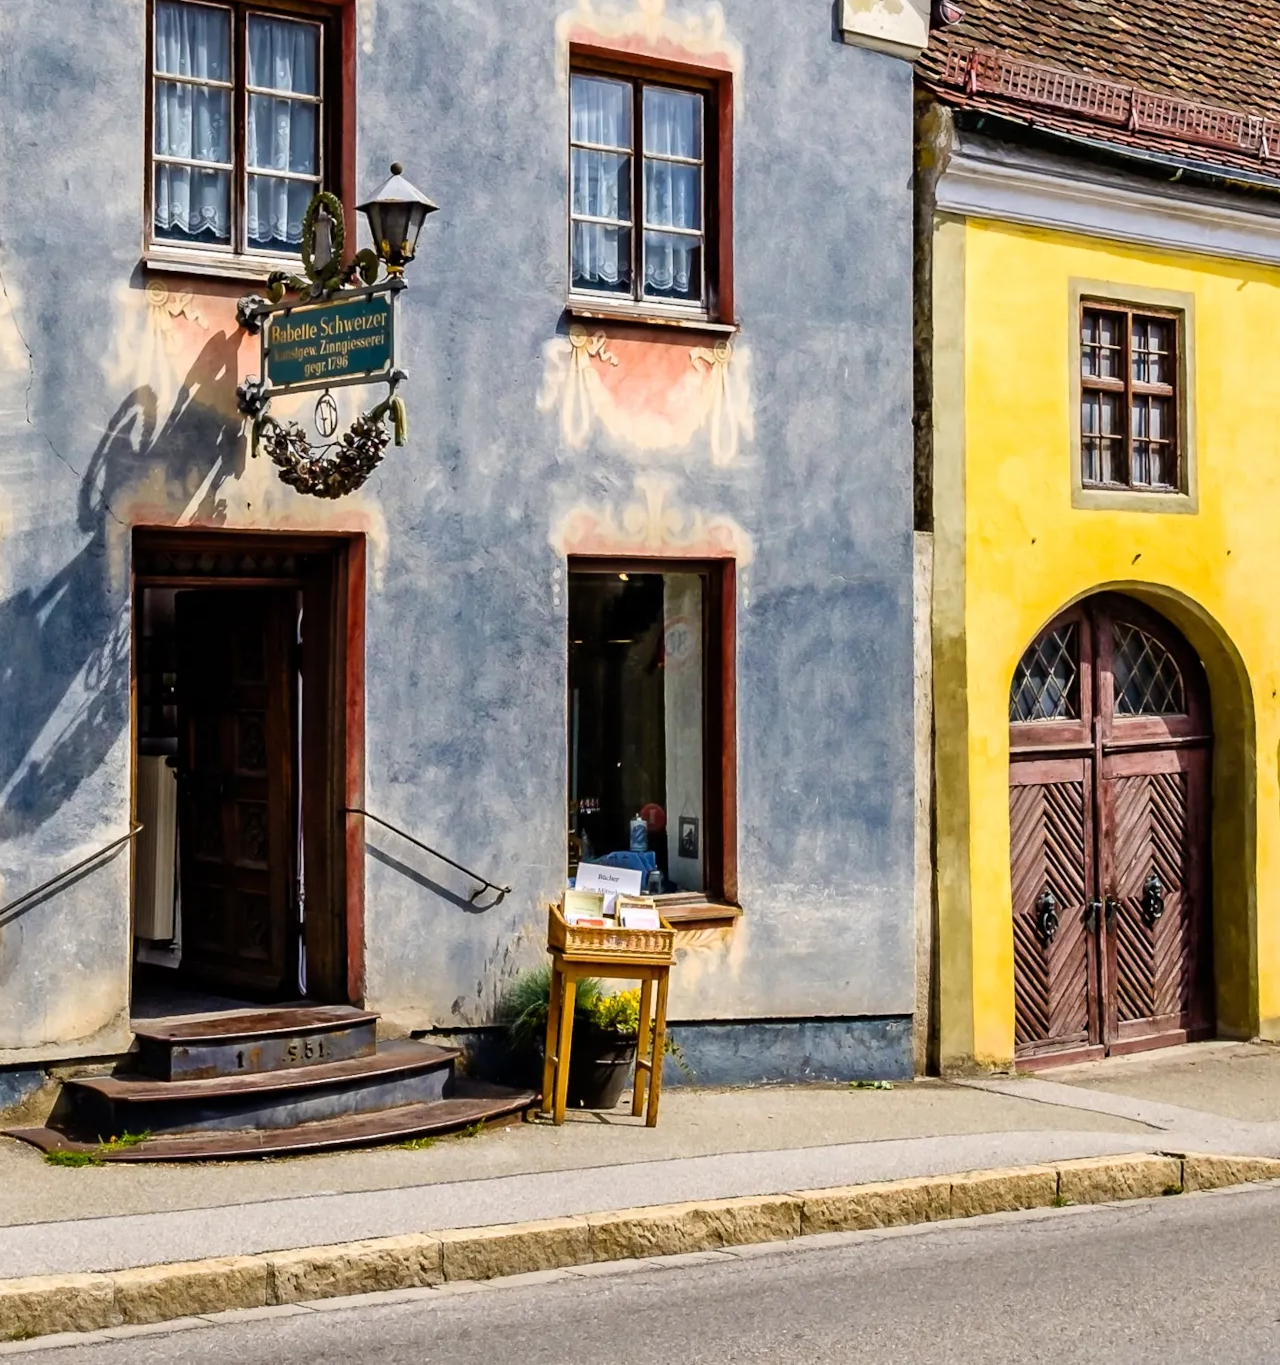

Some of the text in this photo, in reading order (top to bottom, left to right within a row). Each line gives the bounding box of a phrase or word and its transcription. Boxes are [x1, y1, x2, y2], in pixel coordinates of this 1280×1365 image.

[271, 312, 387, 344] Babette Schweizer
[320, 331, 384, 355] Zinngiesserei
[327, 355, 349, 371] 1796
